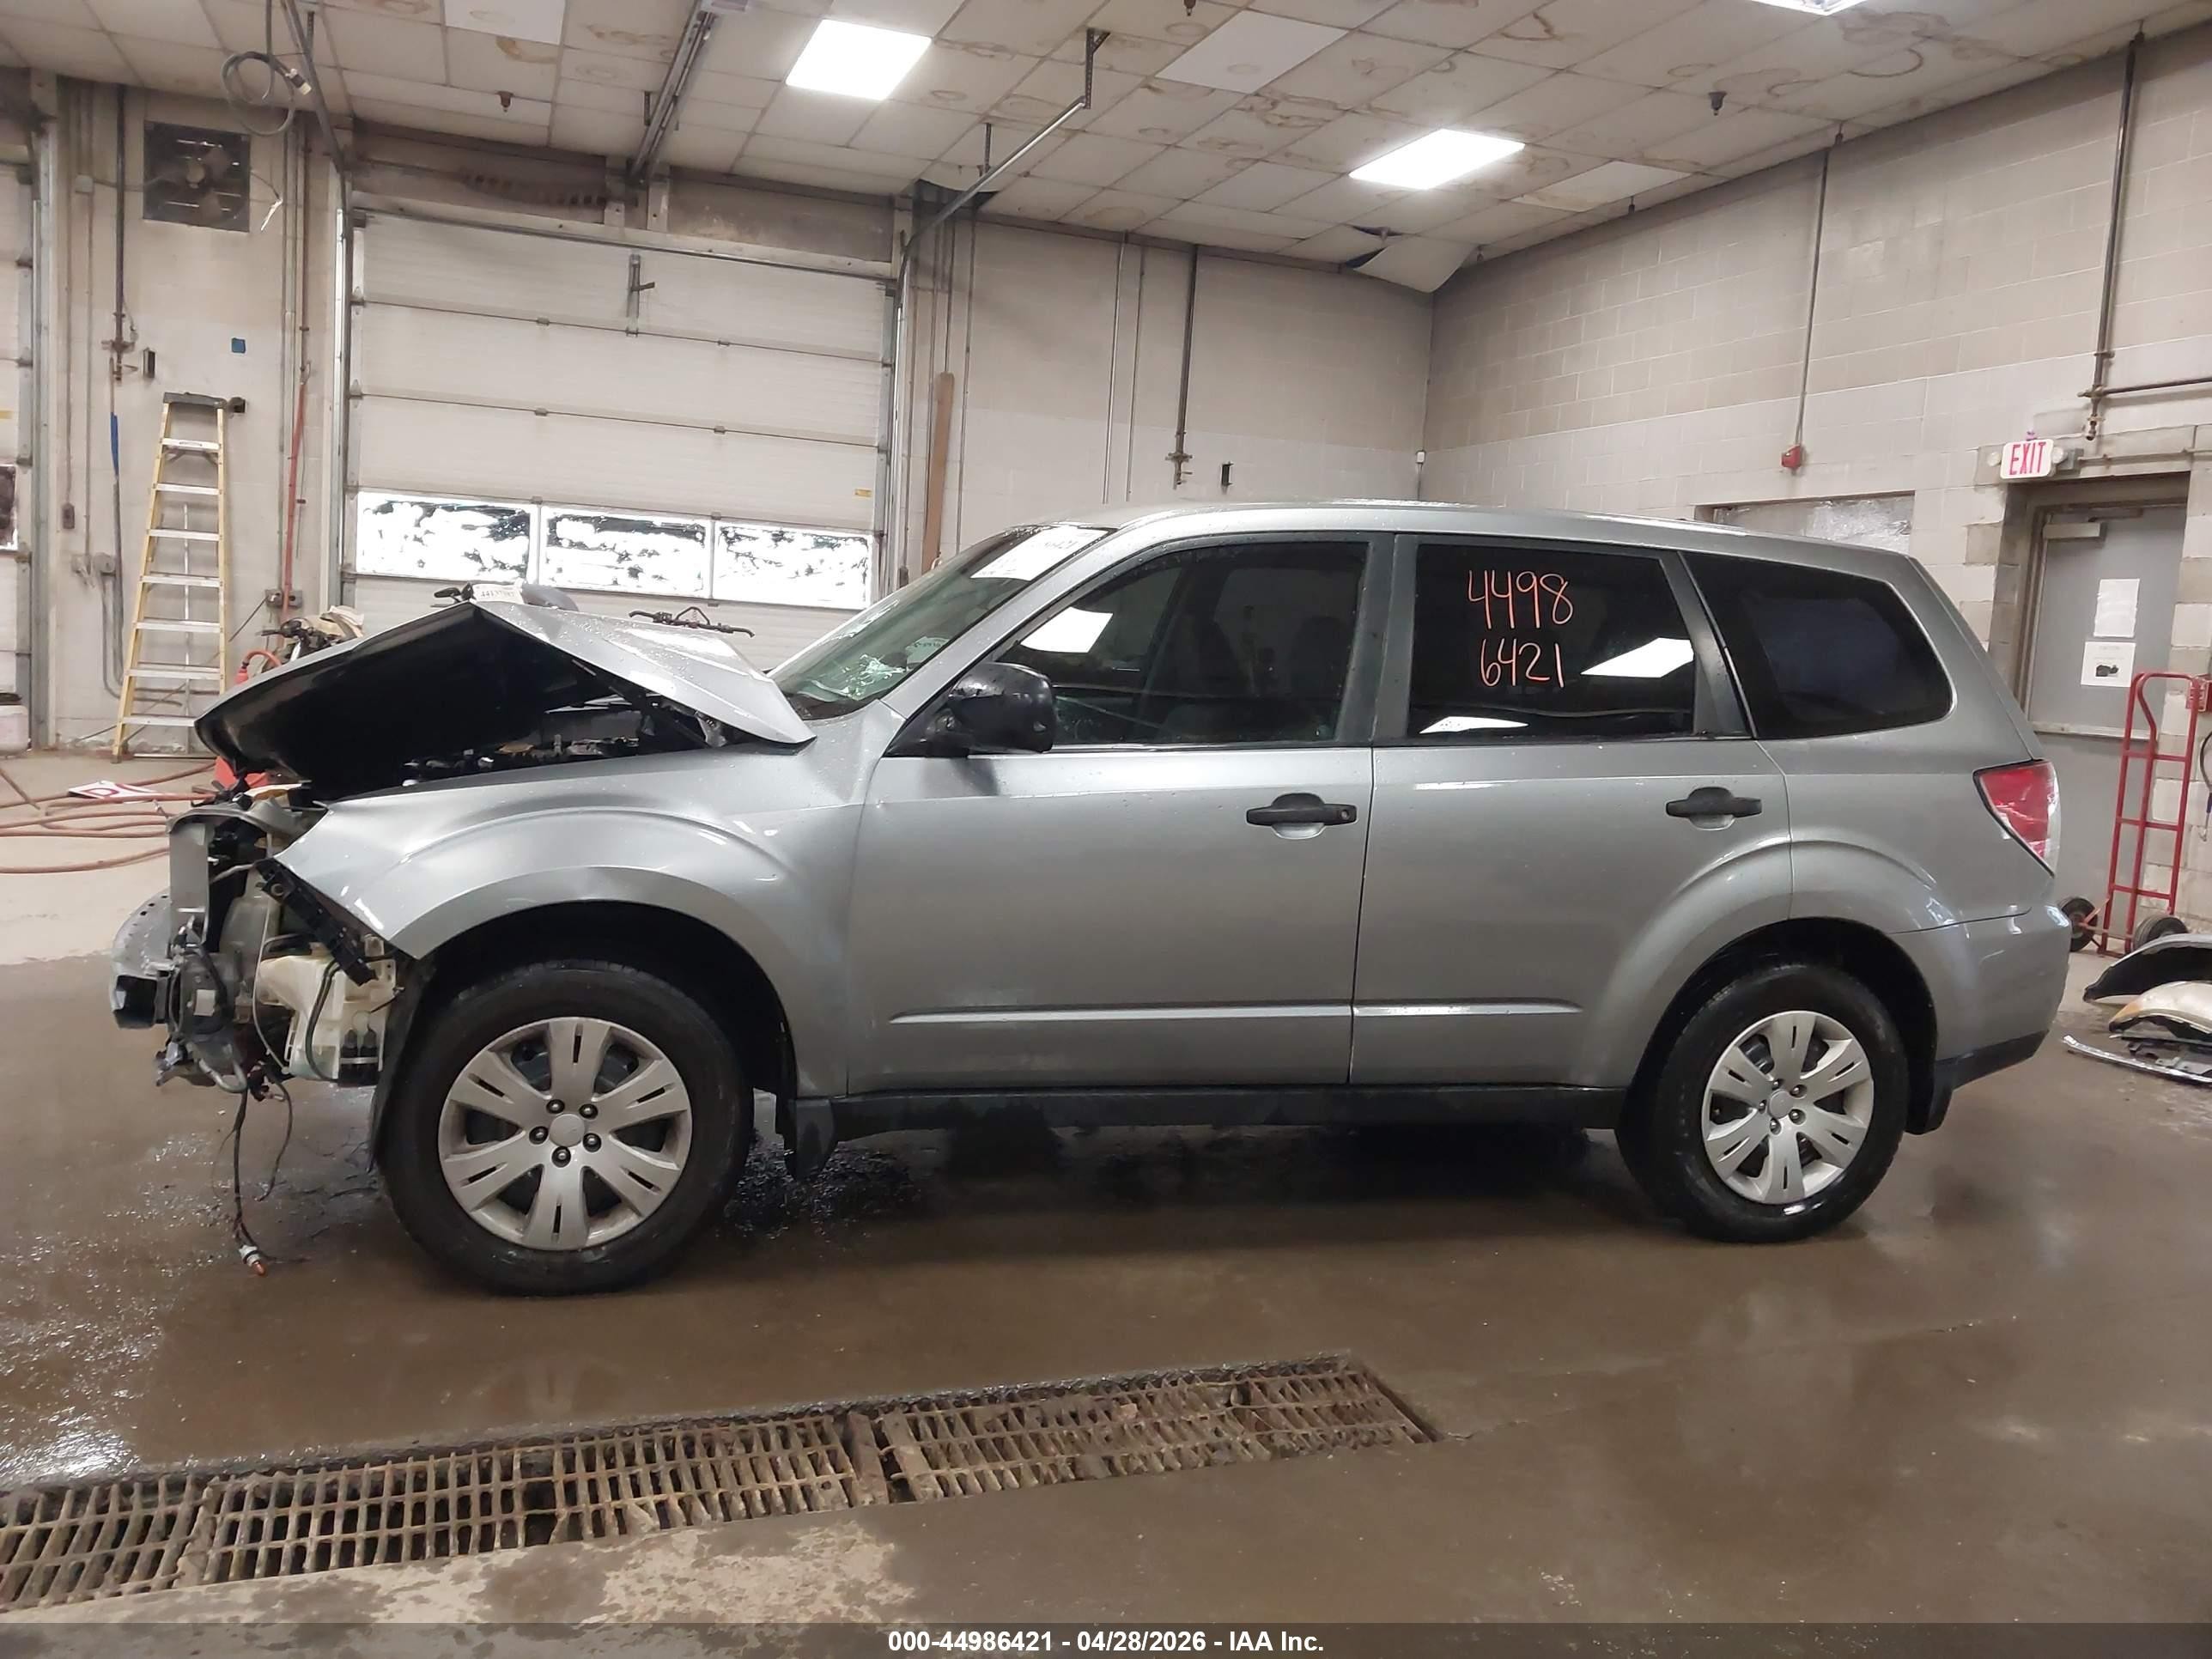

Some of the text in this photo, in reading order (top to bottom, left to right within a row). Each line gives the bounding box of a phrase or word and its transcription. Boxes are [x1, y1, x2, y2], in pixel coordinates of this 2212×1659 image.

[2008, 441, 2047, 476] EXIT
[1468, 569, 1573, 629] 4498
[1480, 637, 1565, 688] 6421
